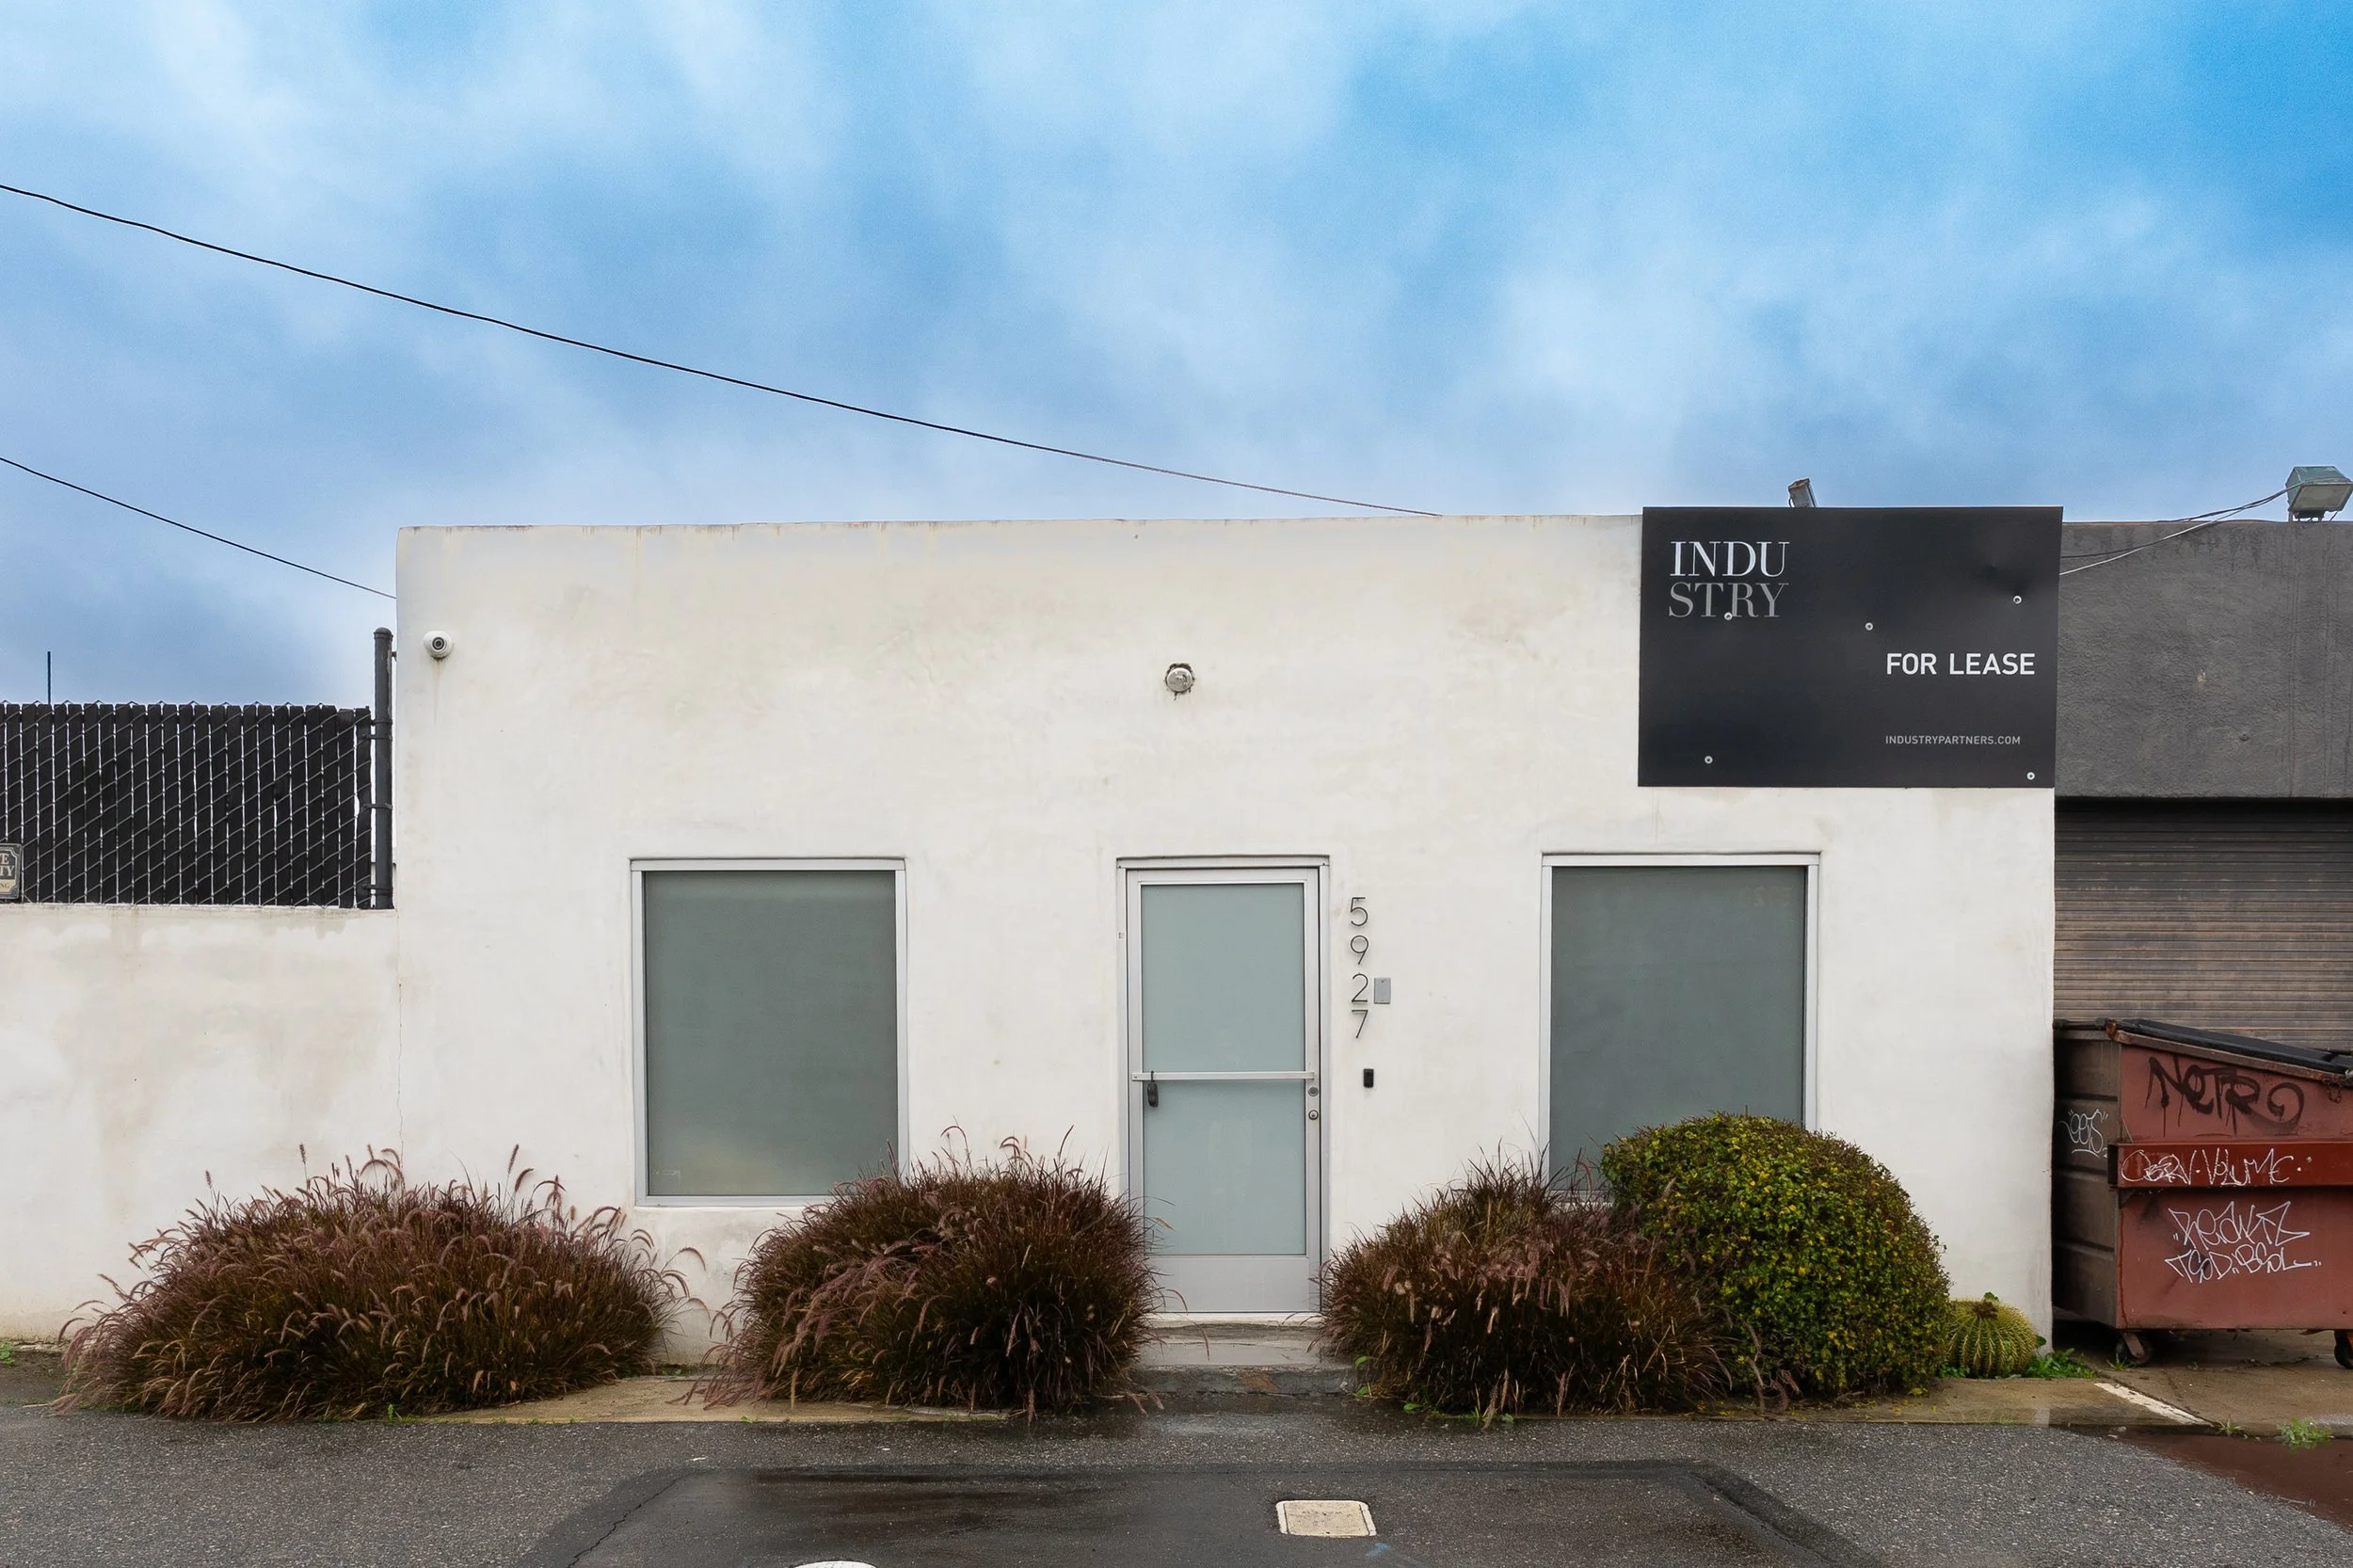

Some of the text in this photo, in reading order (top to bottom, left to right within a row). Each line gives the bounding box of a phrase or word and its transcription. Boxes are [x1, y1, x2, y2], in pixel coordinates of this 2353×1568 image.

[1670, 541, 1789, 577] INDU
[1668, 582, 1789, 618] STRY
[1887, 653, 2036, 675] FOR LEASE
[1885, 735, 2021, 745] INDUSTRYPARTNERS.COM
[1350, 896, 1369, 1039] 5927
